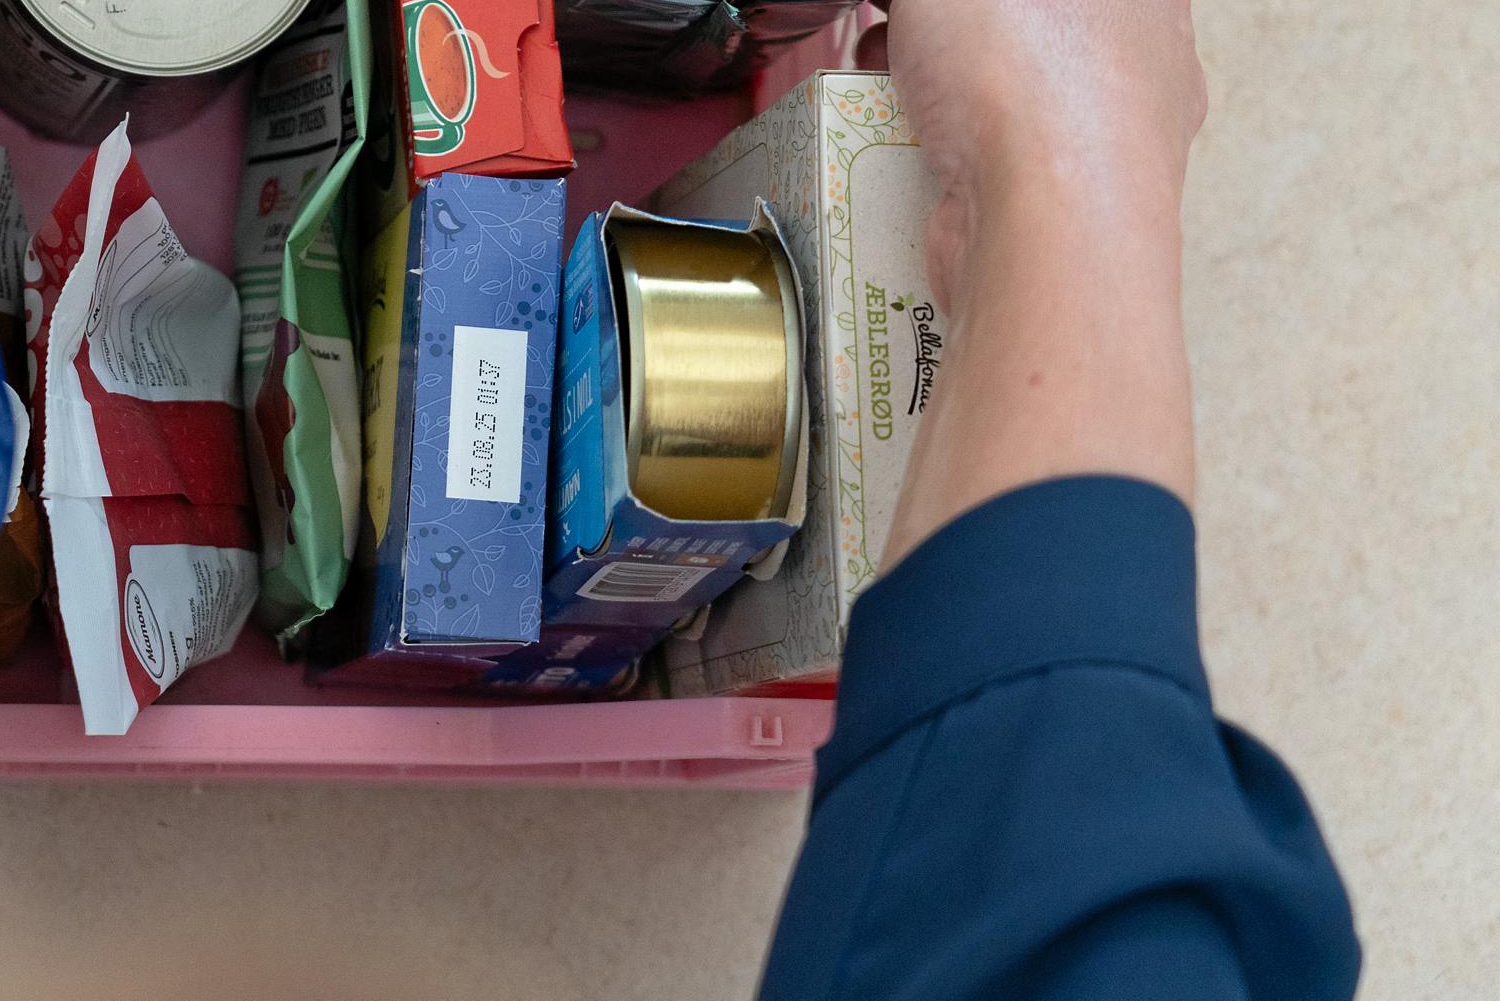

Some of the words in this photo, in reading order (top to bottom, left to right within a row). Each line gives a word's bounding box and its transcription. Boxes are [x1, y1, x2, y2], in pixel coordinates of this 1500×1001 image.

[158, 232, 171, 248] 100
[477, 359, 500, 405] 01:37
[865, 281, 893, 441] ÆBLEGRØD
[470, 411, 496, 489] 23.08.25
[134, 593, 157, 664] Mamone
